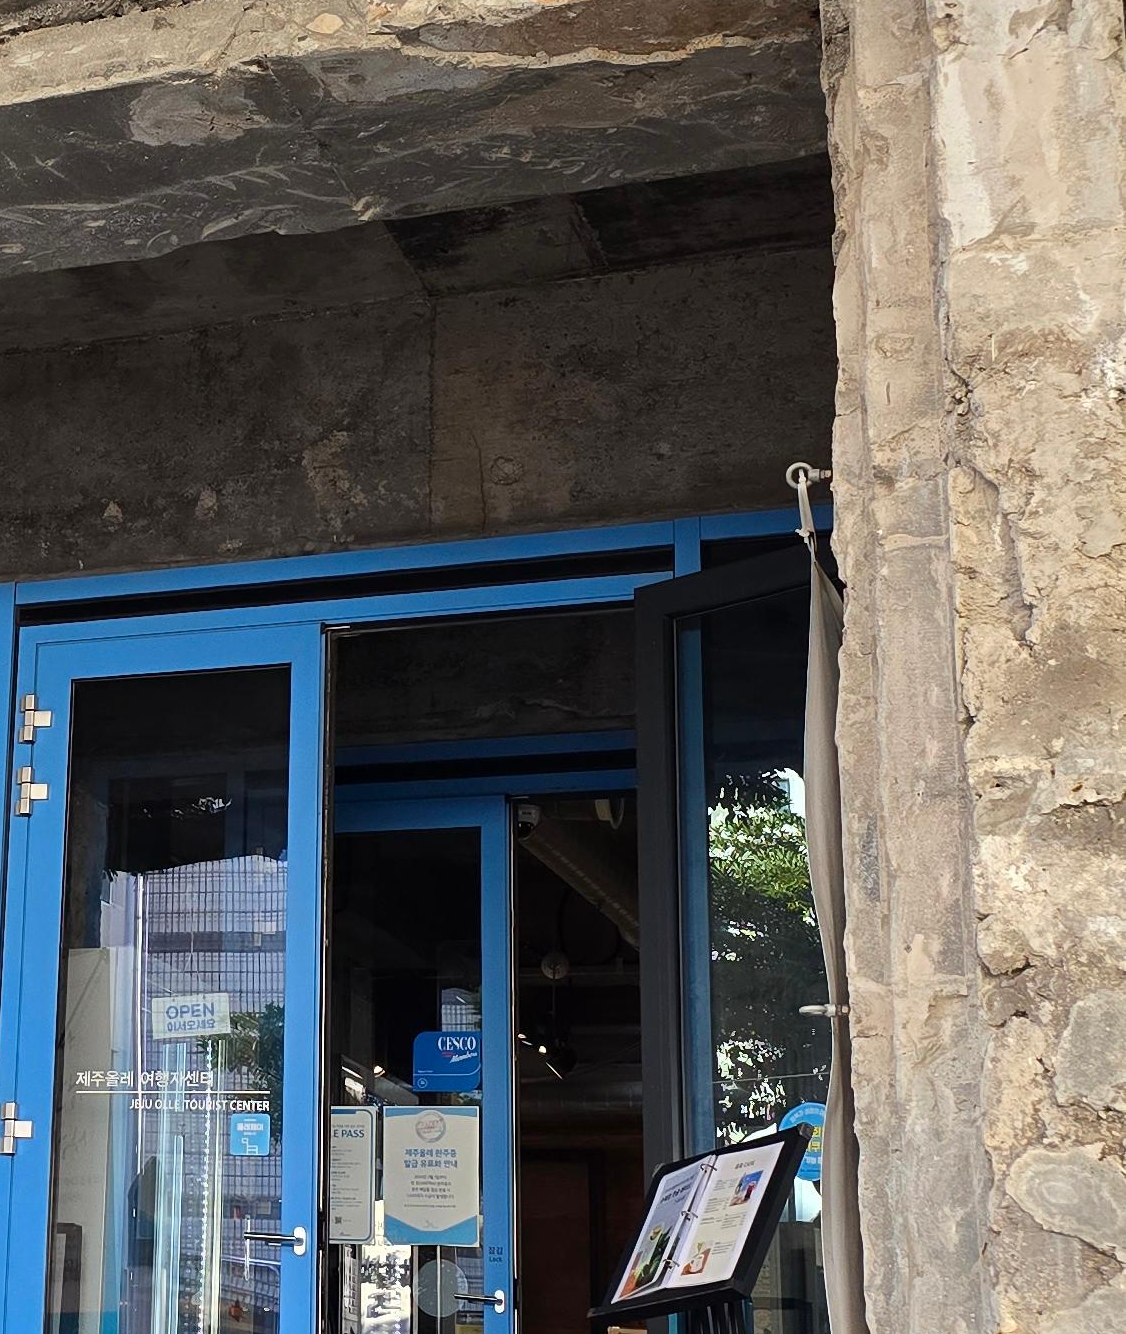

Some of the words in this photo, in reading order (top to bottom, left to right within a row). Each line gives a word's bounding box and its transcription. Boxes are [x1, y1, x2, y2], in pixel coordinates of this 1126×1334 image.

[166, 1002, 214, 1019] OPEN
[438, 1037, 477, 1051] CESCO
[76, 1070, 134, 1088] 제주올레
[141, 1070, 214, 1088] 여행자센터
[130, 1099, 153, 1110] JEJU
[155, 1099, 181, 1110] OLLE
[184, 1098, 228, 1111] TOURIST
[230, 1100, 270, 1111] CENTER
[341, 1129, 365, 1138] PASS
